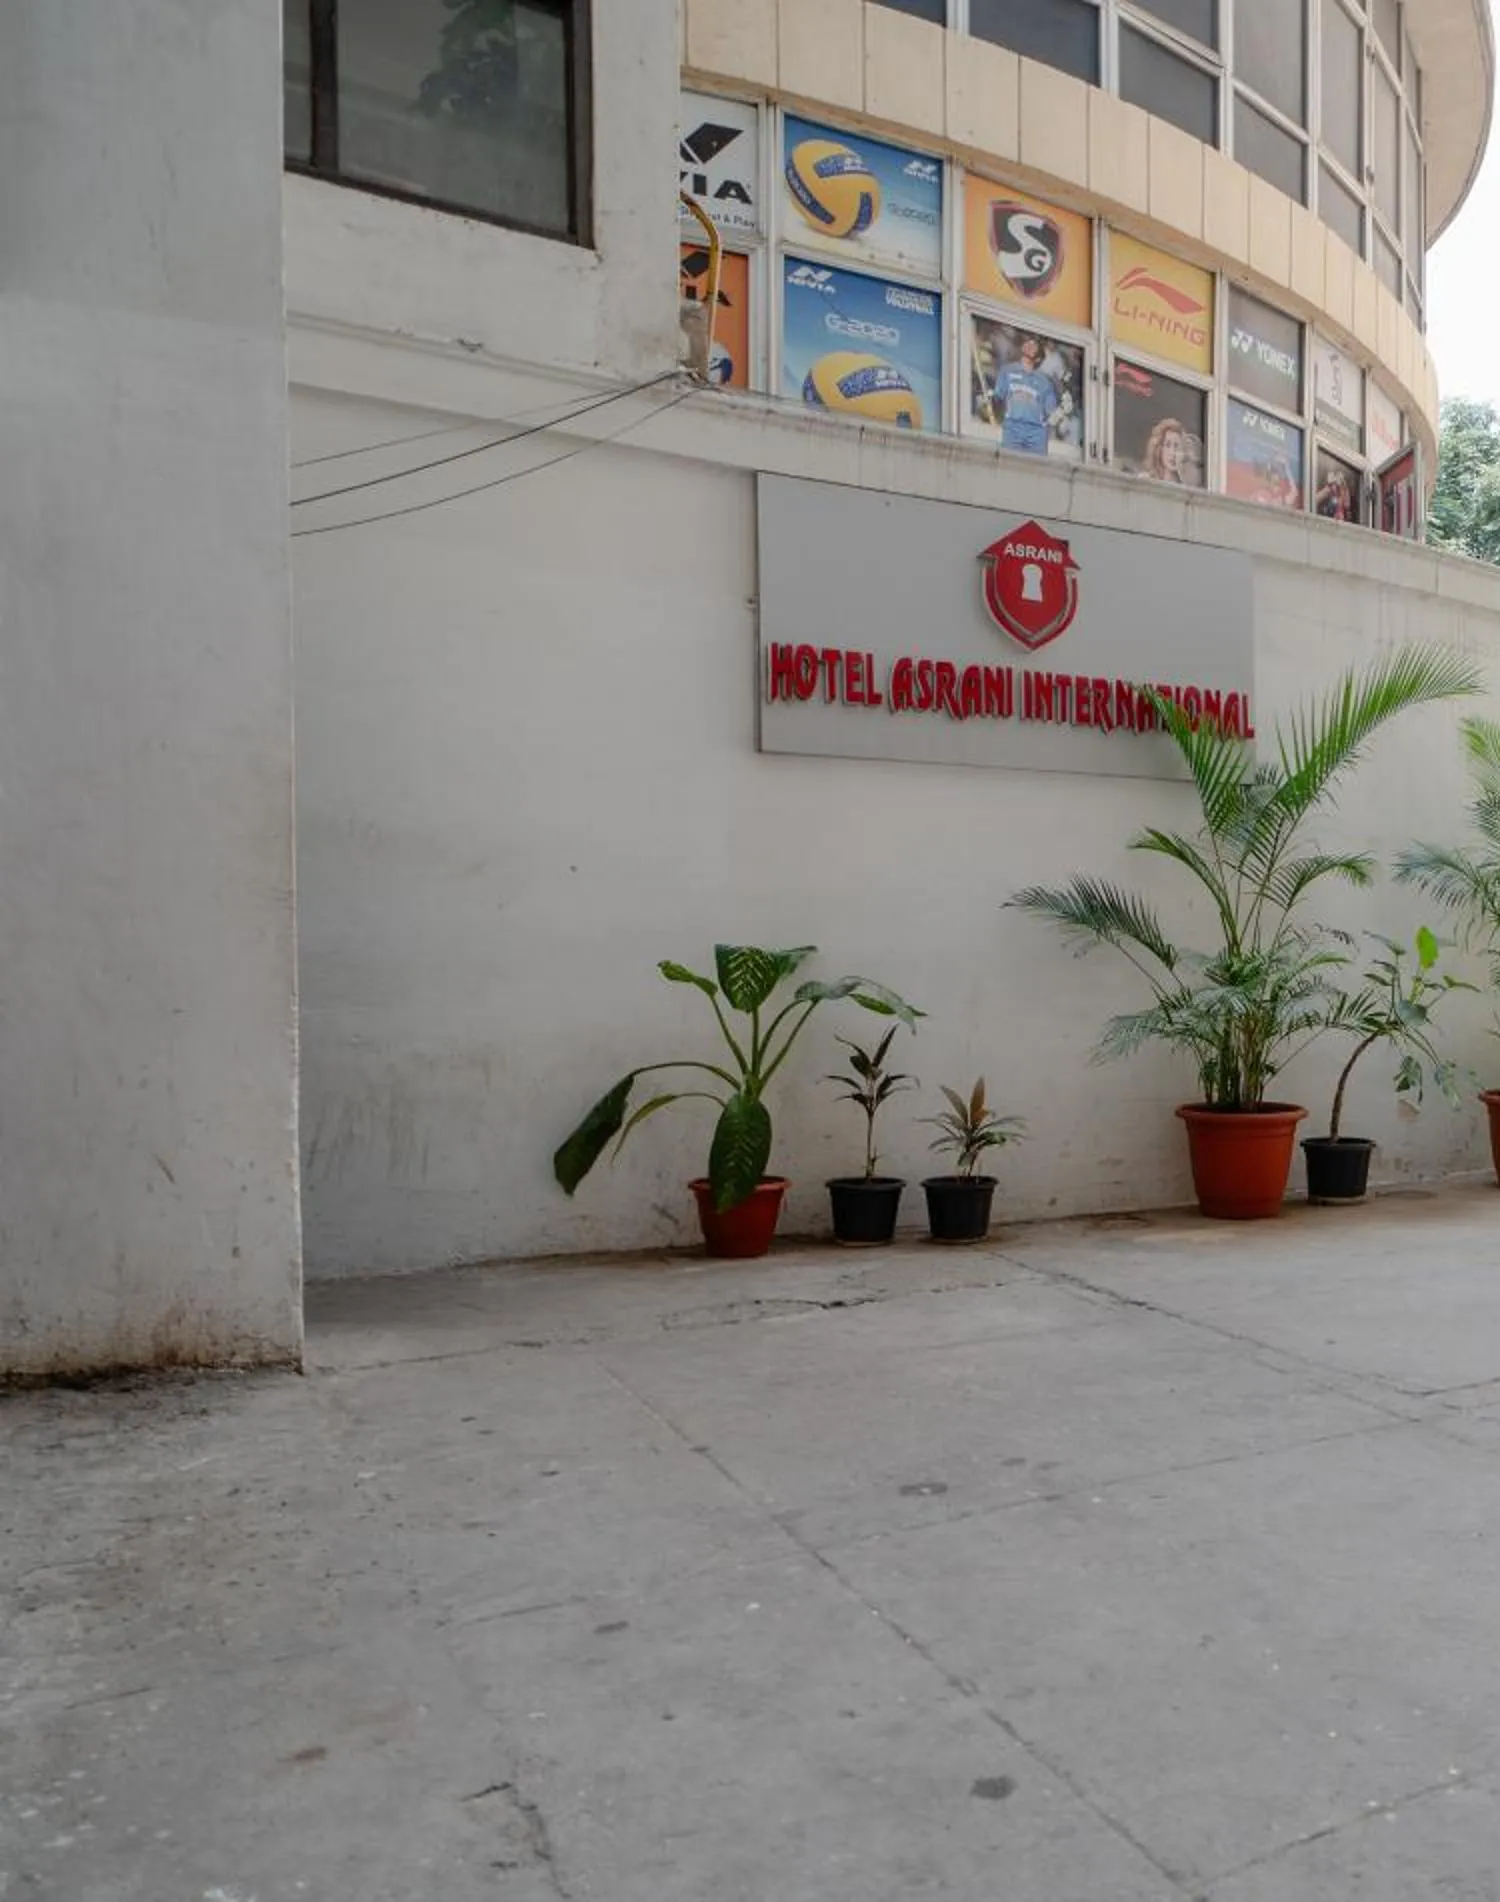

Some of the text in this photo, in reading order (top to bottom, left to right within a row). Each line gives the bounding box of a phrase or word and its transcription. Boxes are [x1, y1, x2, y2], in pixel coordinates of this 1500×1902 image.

[680, 169, 753, 205] IA
[998, 213, 1052, 278] SG
[1114, 296, 1205, 347] LI-NING
[1256, 336, 1296, 380] YONEX
[1004, 542, 1063, 564] ASRANI
[770, 641, 883, 705] HOTEL
[890, 656, 1014, 721] ASRANI
